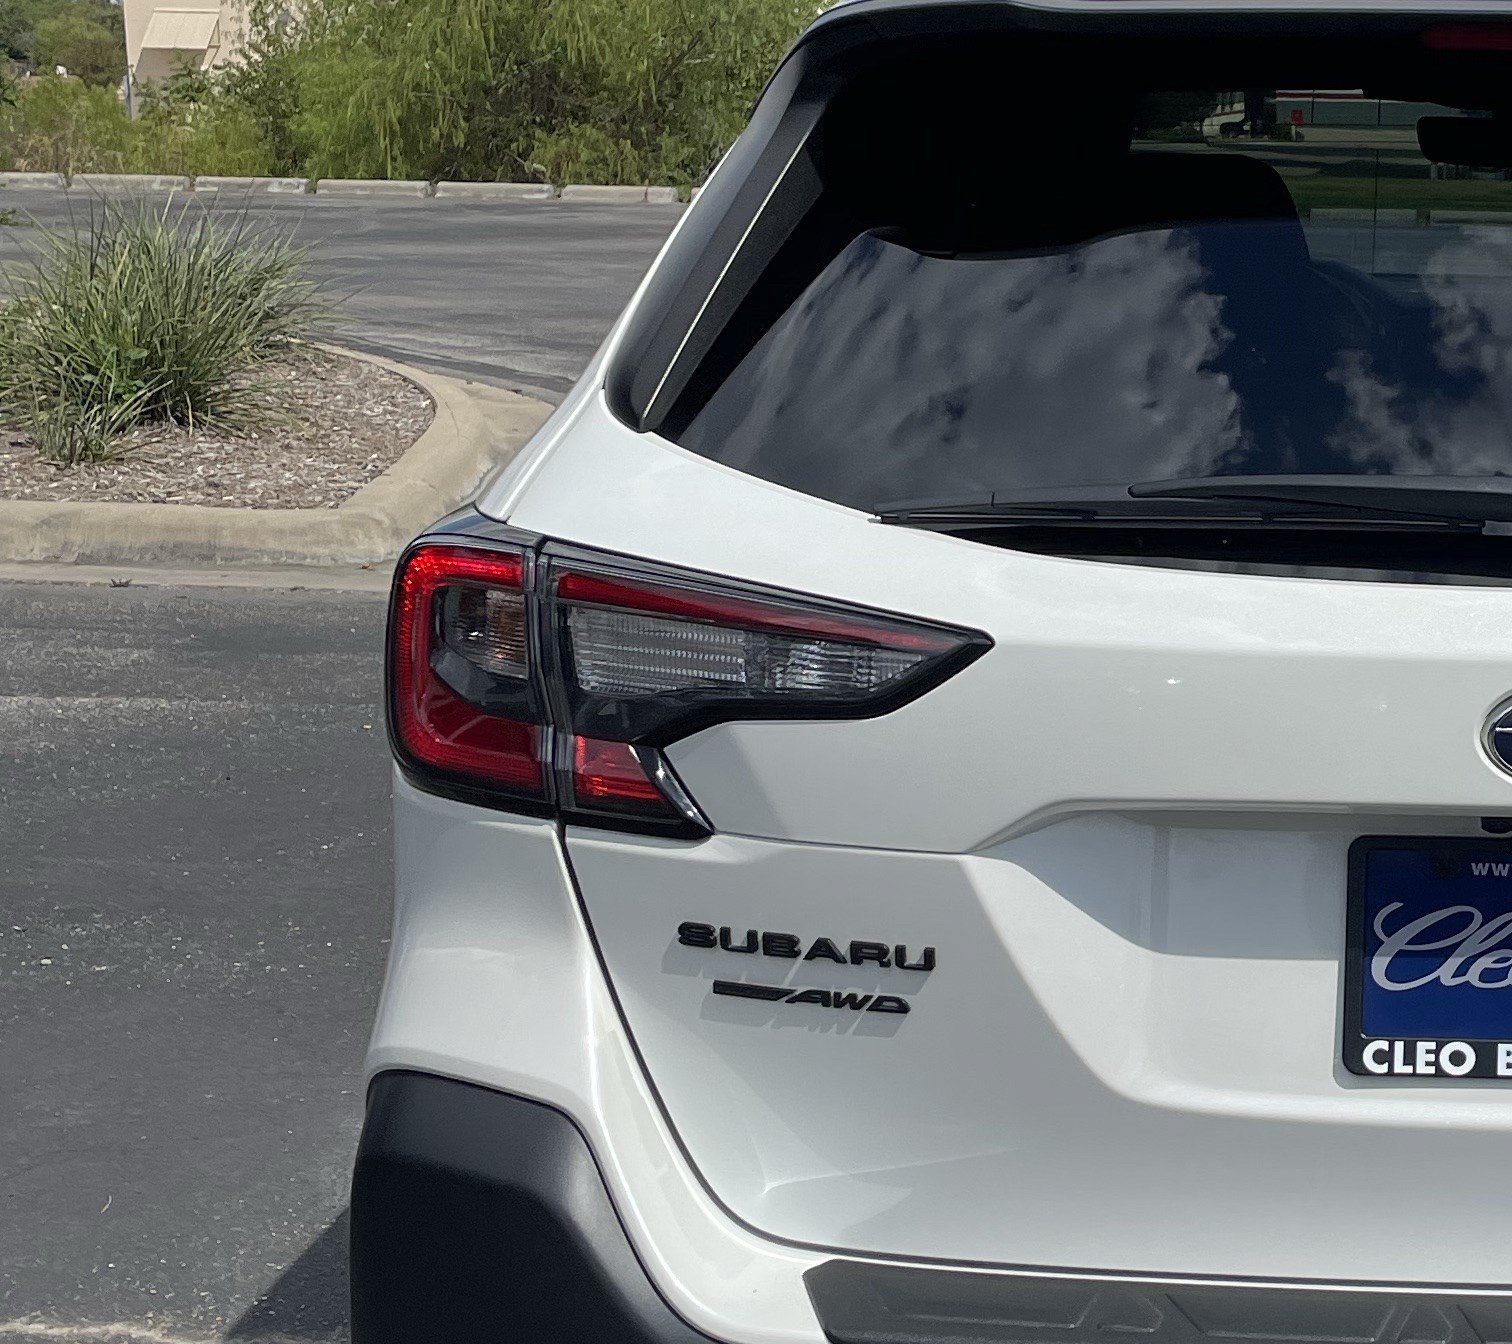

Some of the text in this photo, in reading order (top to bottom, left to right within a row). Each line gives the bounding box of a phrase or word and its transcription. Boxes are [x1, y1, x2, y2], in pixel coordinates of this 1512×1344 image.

[677, 920, 937, 972] SUBARU
[784, 988, 912, 1015] AWD
[1362, 1040, 1477, 1076] CLEO
